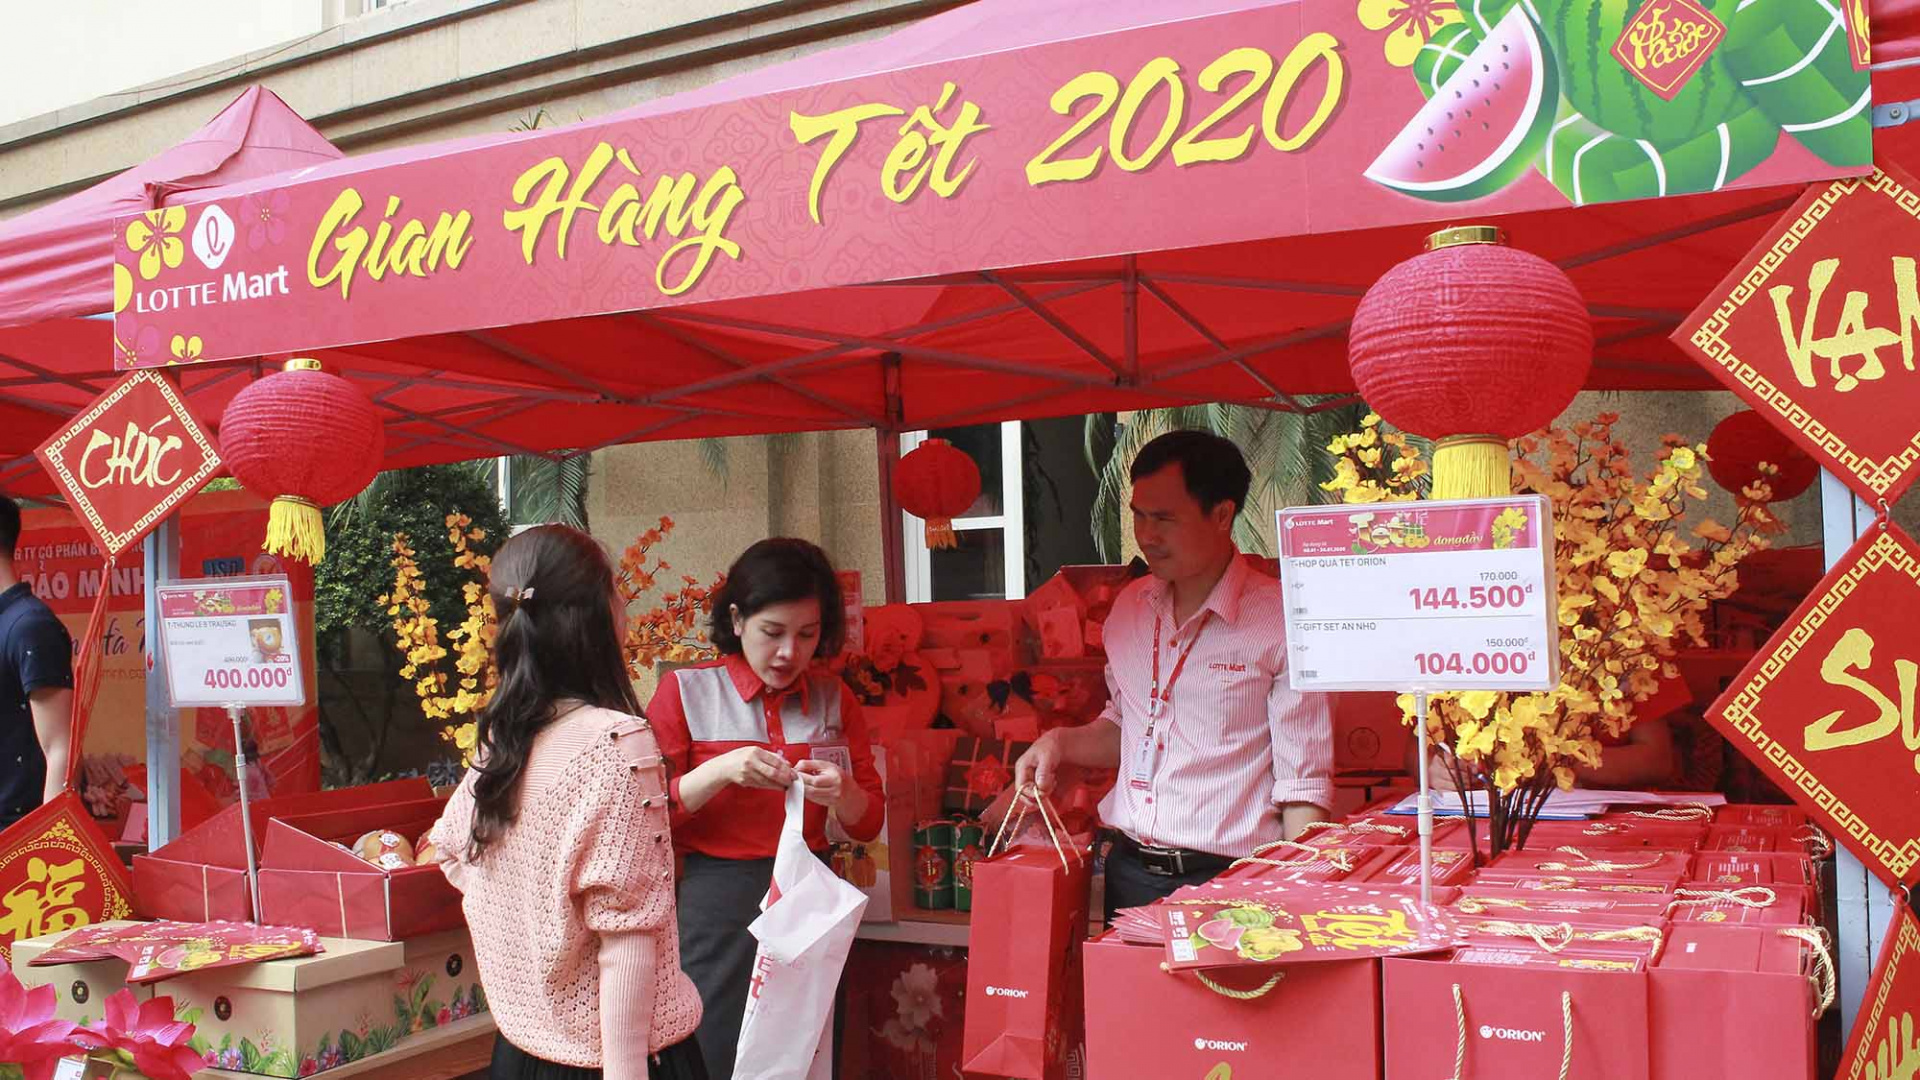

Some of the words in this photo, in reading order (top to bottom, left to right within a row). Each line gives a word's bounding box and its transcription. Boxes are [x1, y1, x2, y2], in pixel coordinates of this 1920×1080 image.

[306, 187, 474, 300] Gian
[503, 141, 747, 296] Hàng
[790, 81, 991, 224] Tết
[1025, 32, 1344, 186] 2020
[136, 282, 217, 313] LOTTE
[222, 265, 289, 302] Mart
[80, 415, 183, 488] CHÚC
[1319, 559, 1338, 568] QUA
[1340, 558, 1355, 567] TET
[1357, 557, 1387, 567] ORION
[78, 567, 145, 599] MNH
[1323, 622, 1340, 631] SET
[1342, 622, 1355, 631] AN
[1356, 621, 1377, 631] NHO
[1229, 662, 1246, 672] Mart
[996, 987, 1026, 999] ORION
[1495, 1028, 1542, 1042] ORION
[1207, 1039, 1245, 1051] ORION
